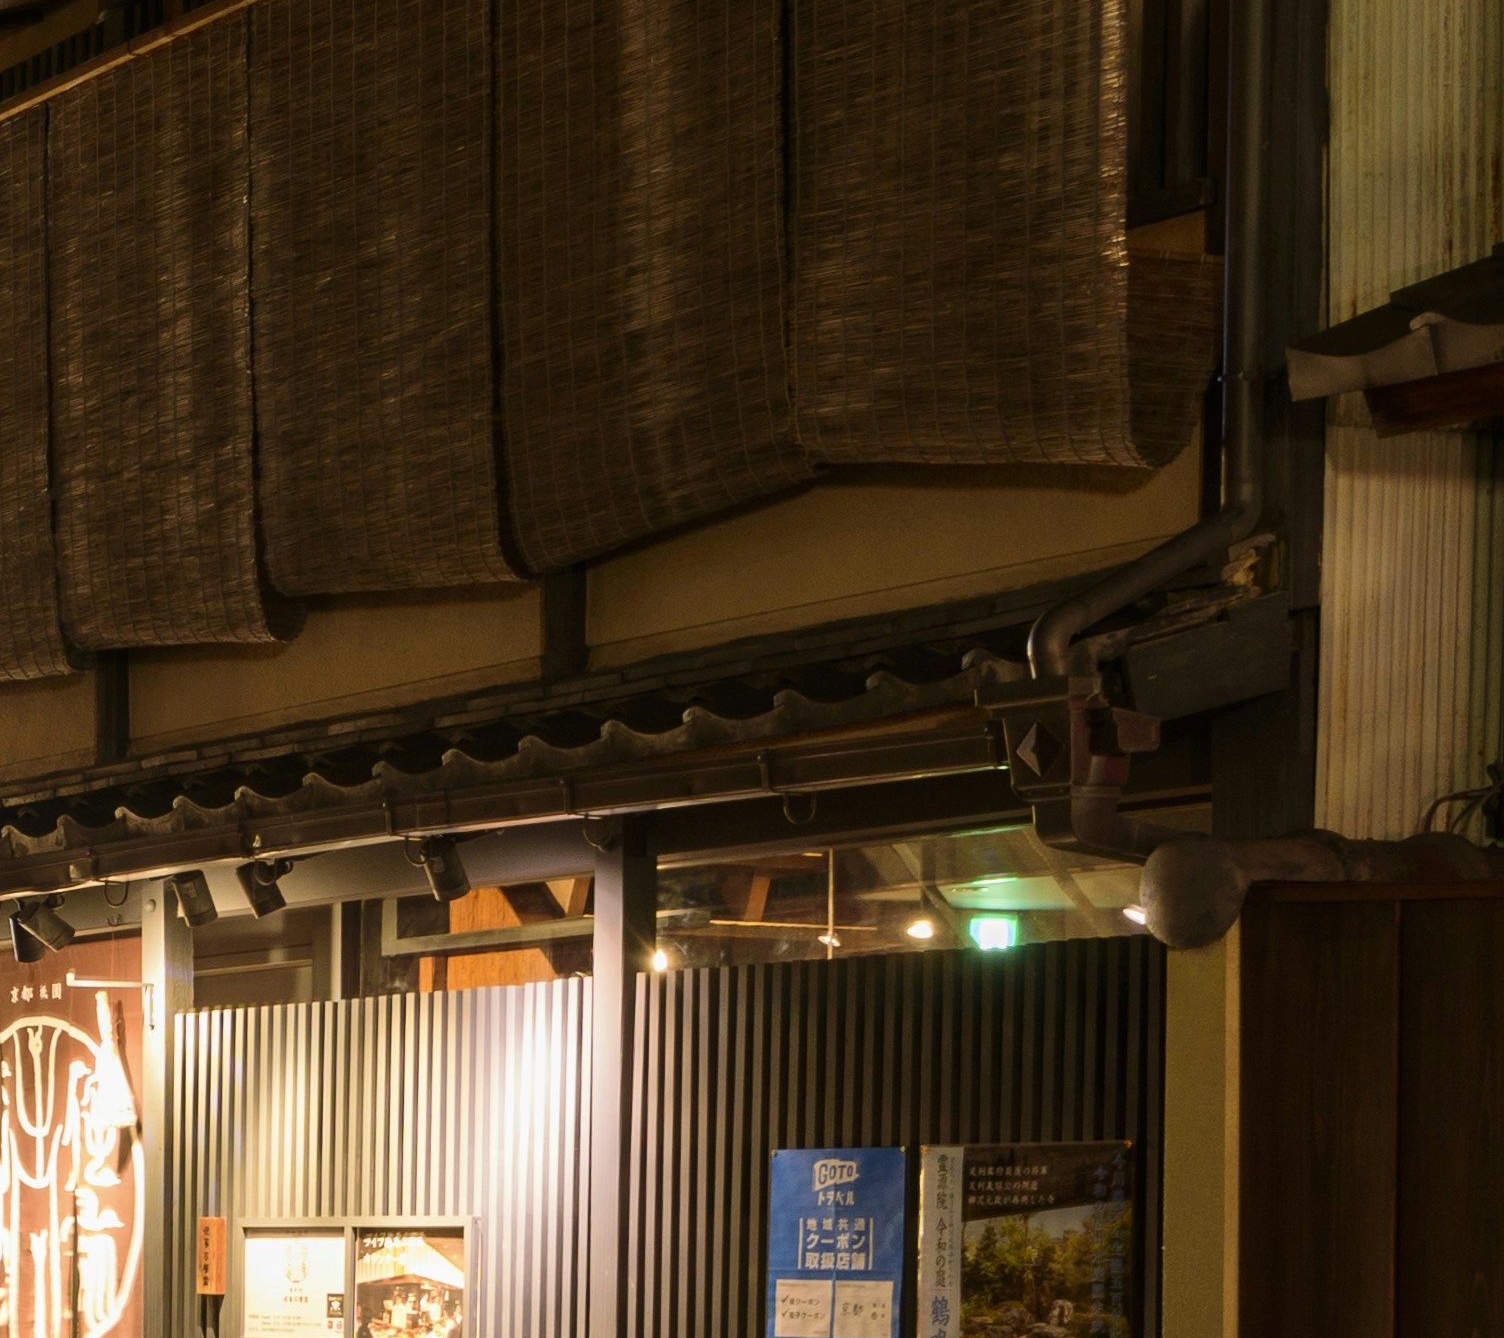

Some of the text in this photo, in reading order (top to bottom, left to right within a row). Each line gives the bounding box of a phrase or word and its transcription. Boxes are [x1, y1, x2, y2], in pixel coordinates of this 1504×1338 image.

[817, 1190, 856, 1206] トラベル
[806, 1217, 866, 1232] 地域共通
[806, 1233, 866, 1249] クーポン
[804, 1252, 866, 1270] 取扱店舗
